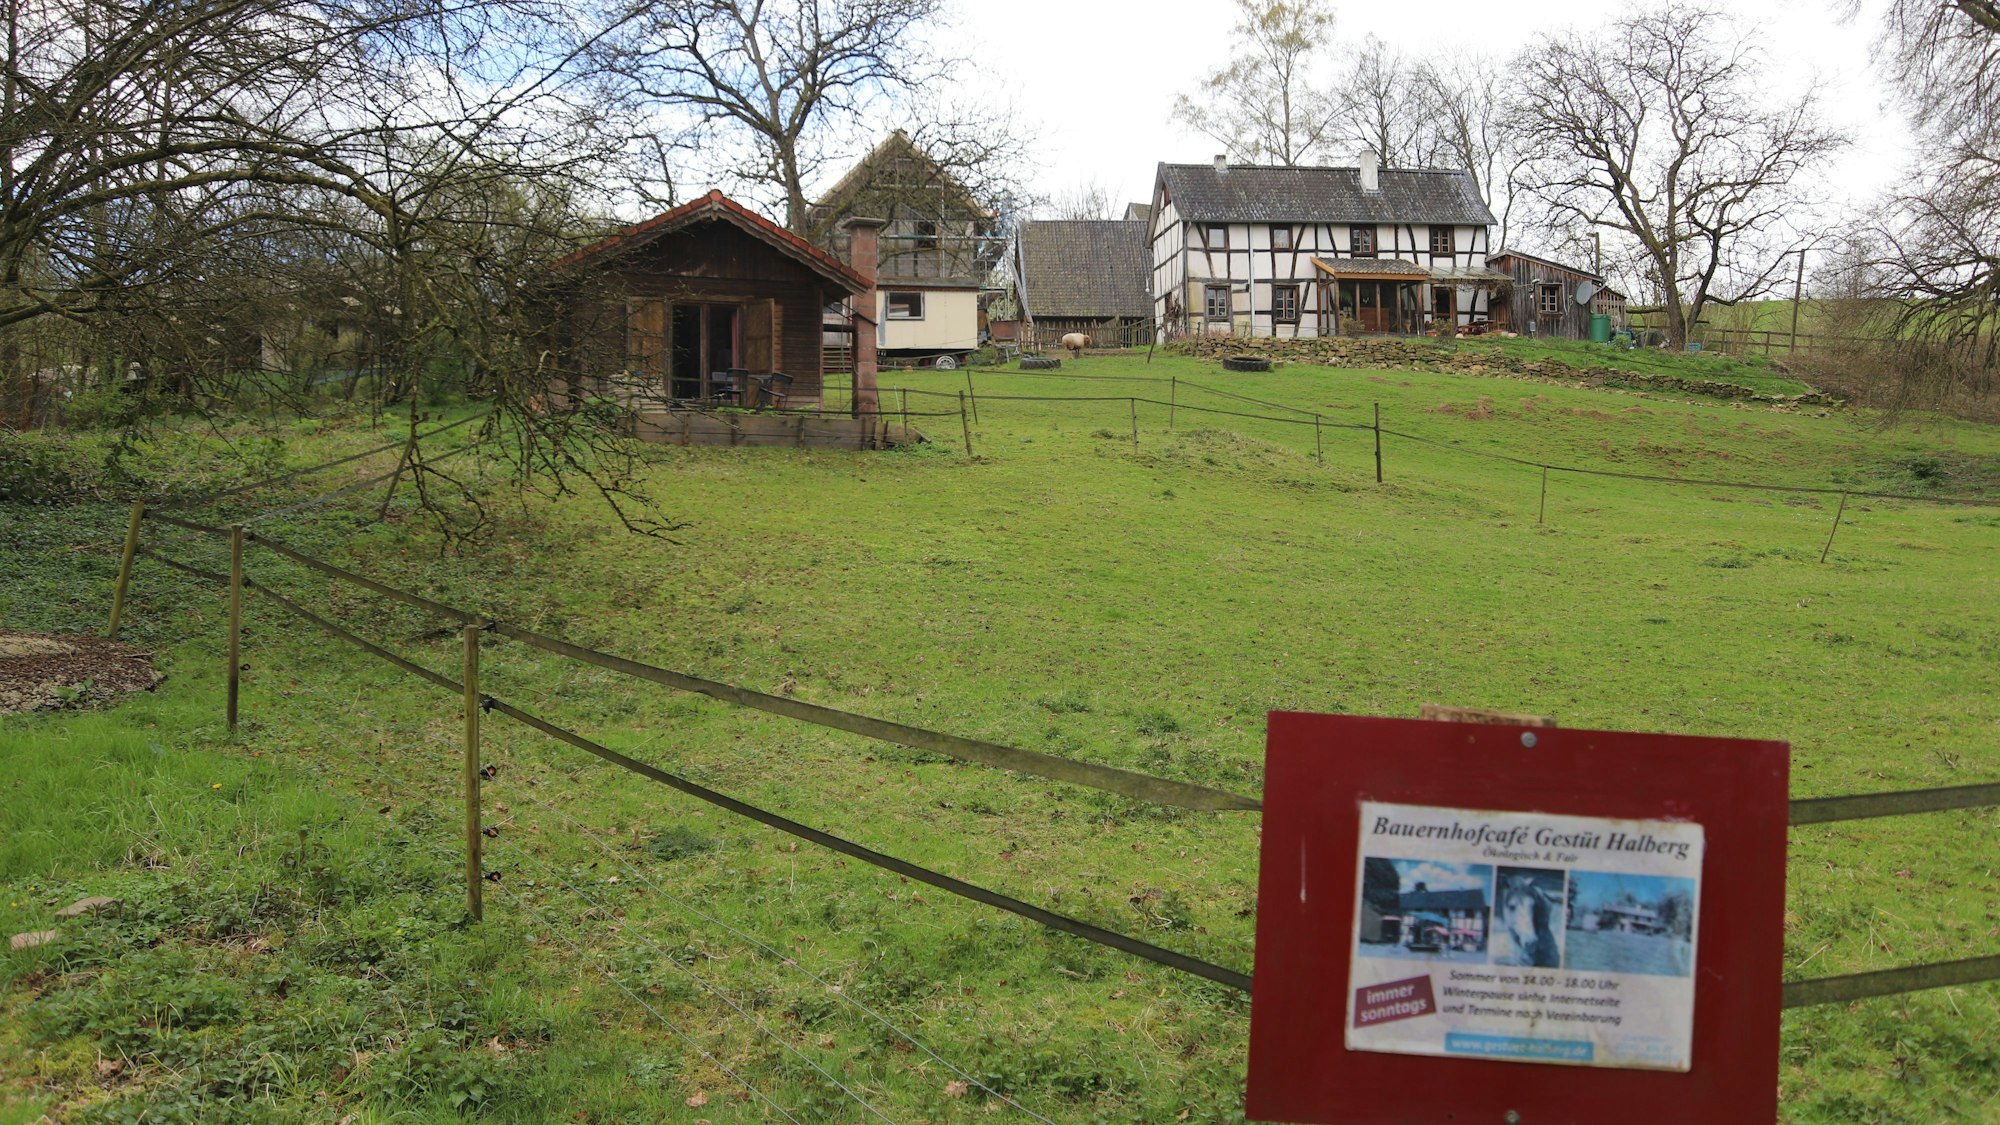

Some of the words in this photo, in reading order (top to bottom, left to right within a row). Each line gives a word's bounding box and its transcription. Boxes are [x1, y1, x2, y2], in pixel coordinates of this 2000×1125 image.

[1373, 816, 1530, 848] Bauernhofcafé
[1535, 826, 1601, 849] Gestüt
[1607, 832, 1690, 861] Halberg
[1483, 845, 1539, 861] Ökologisch
[1556, 851, 1578, 862] Fair
[1448, 970, 1495, 983] Sommer
[1500, 975, 1519, 983] von
[1564, 977, 1596, 989] 18.00
[1598, 979, 1620, 990] Uhr
[1366, 984, 1415, 1004] immer
[1443, 986, 1514, 1001] Winterpause
[1550, 995, 1620, 1008] Internetseite
[1360, 998, 1427, 1022] sonntags
[1442, 1004, 1464, 1014] und
[1468, 1005, 1512, 1018] Termine
[1546, 1009, 1622, 1027] Vereinbarung
